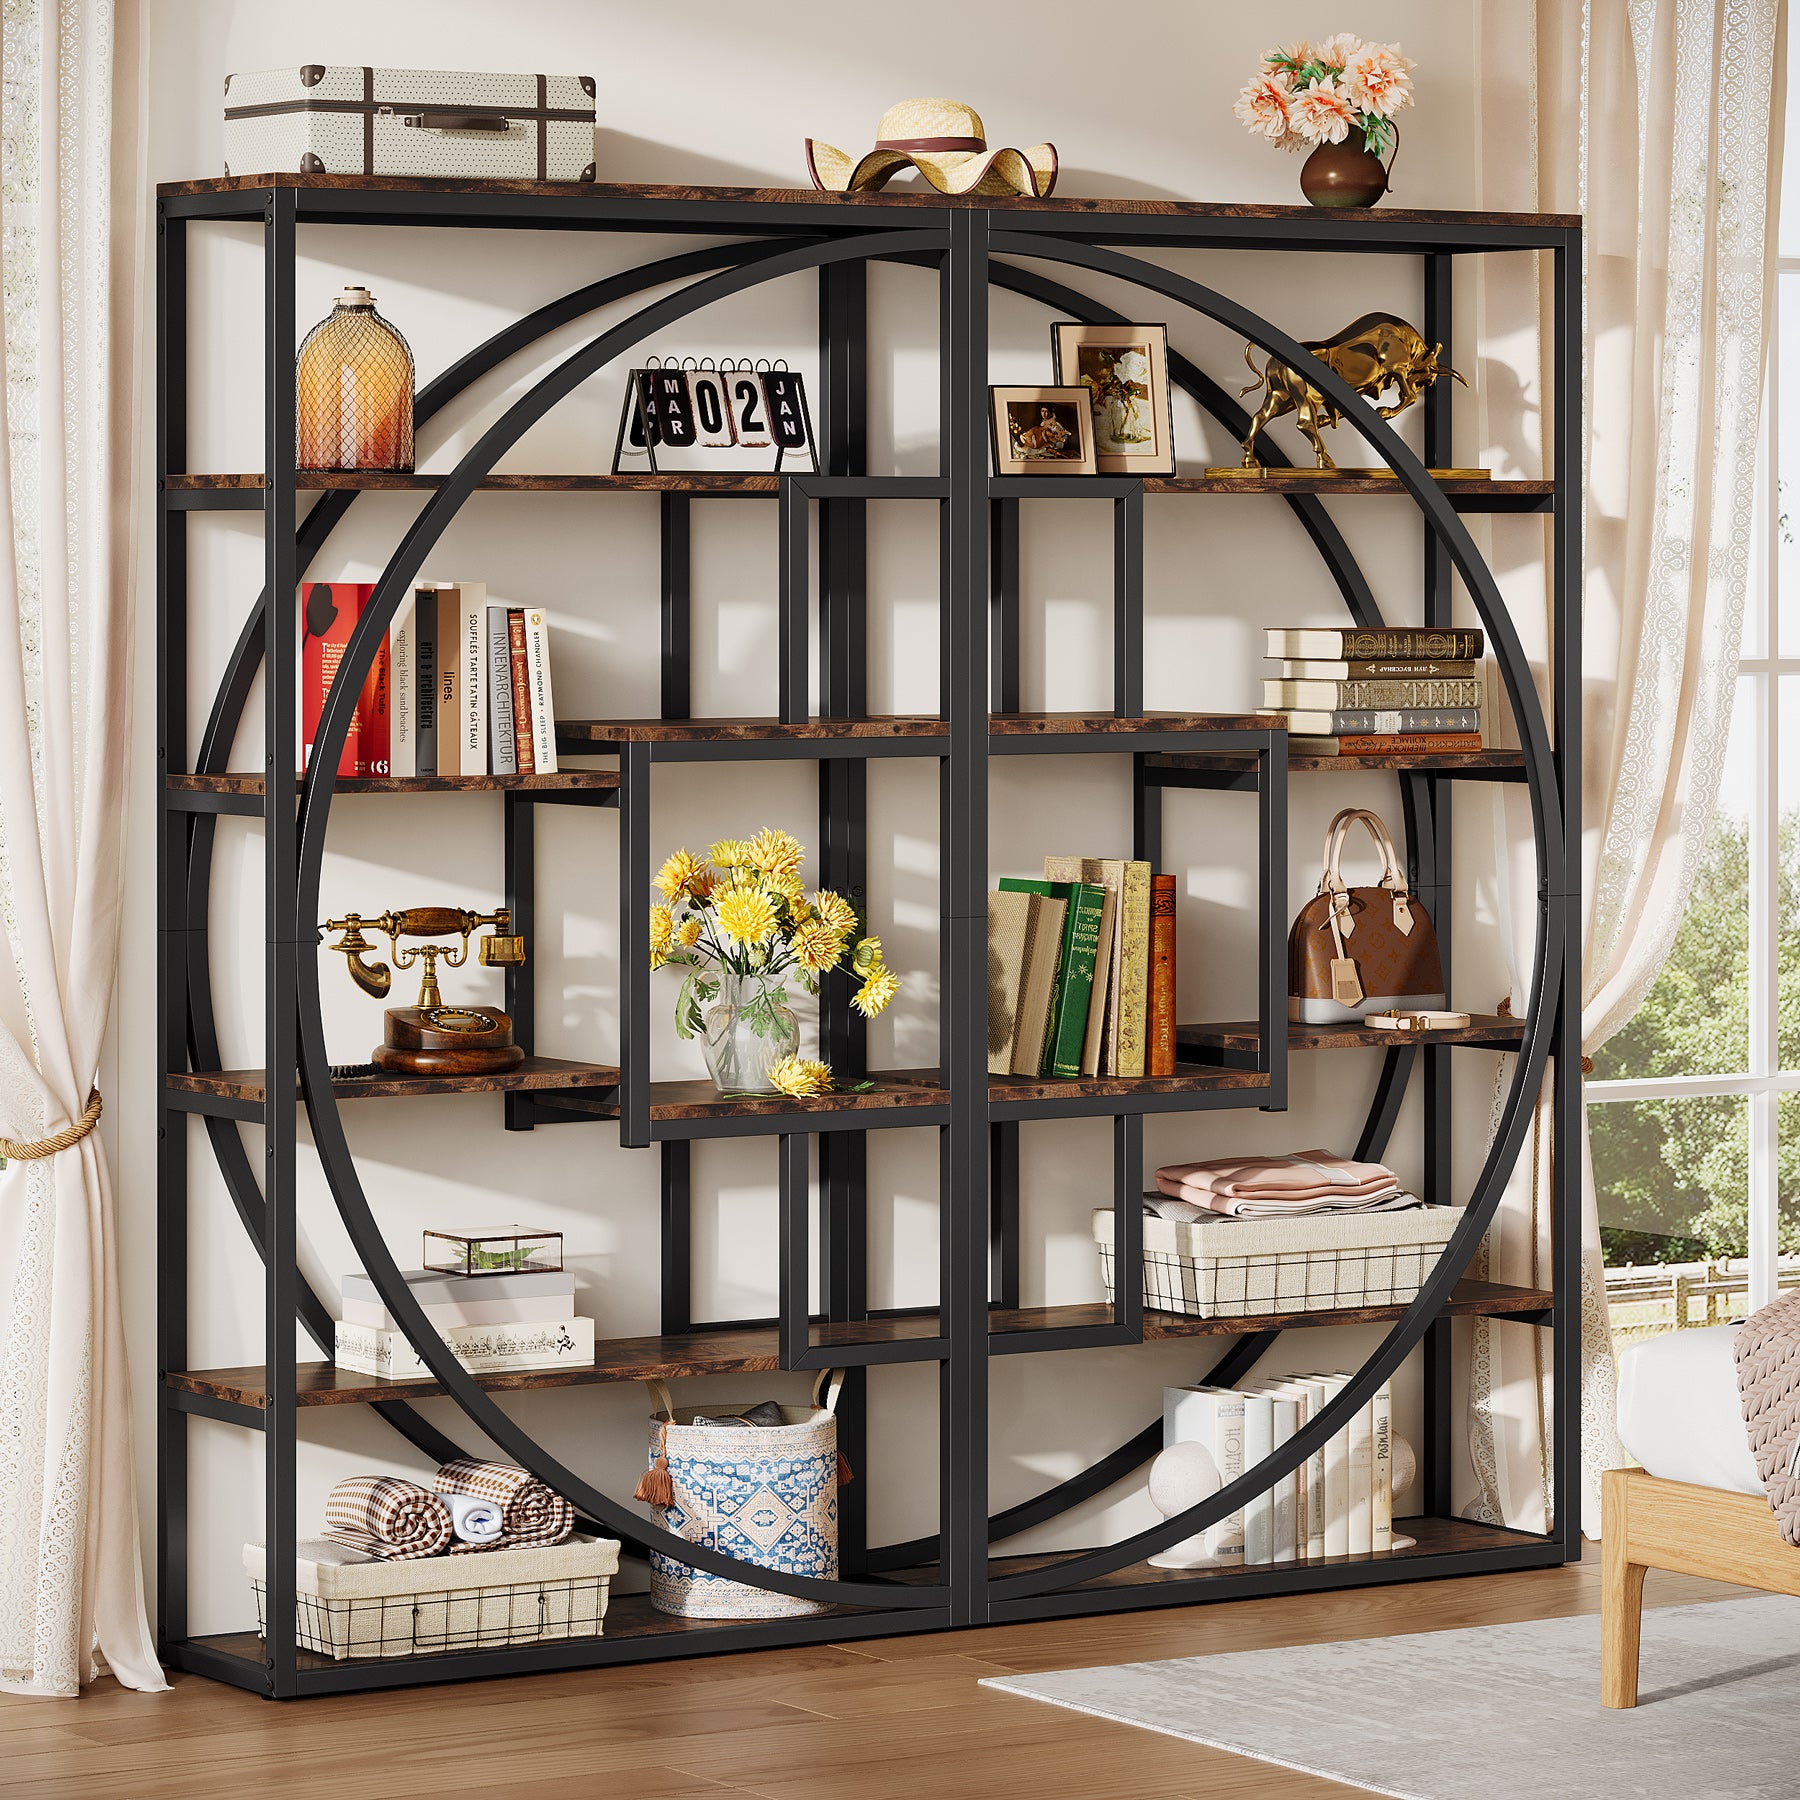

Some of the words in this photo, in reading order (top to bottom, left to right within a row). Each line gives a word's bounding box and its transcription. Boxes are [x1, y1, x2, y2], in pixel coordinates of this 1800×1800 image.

[664, 379, 684, 435] MAR
[776, 381, 796, 435] JAN
[397, 630, 409, 667] exploring
[420, 642, 434, 659] arts
[470, 614, 480, 654] SOUFFLÉS
[533, 631, 542, 668] CHANDLER
[378, 668, 386, 691] Black
[400, 669, 409, 691] black
[471, 657, 479, 682] TARTE
[400, 692, 409, 711] sand
[420, 675, 434, 729] architecture
[444, 671, 455, 704] lines.
[471, 684, 479, 709] TATIN
[493, 632, 513, 764] INNENARCHITEKTUR
[537, 671, 545, 706] RAYMOND
[378, 694, 386, 715] Tulip
[400, 711, 409, 743] beaches
[470, 711, 481, 750] GÂTEAUX
[539, 715, 547, 734] SLEEP
[1436, 740, 1476, 749] ЗАПИСКИ
[1224, 1428, 1241, 1483] ОНДОН
